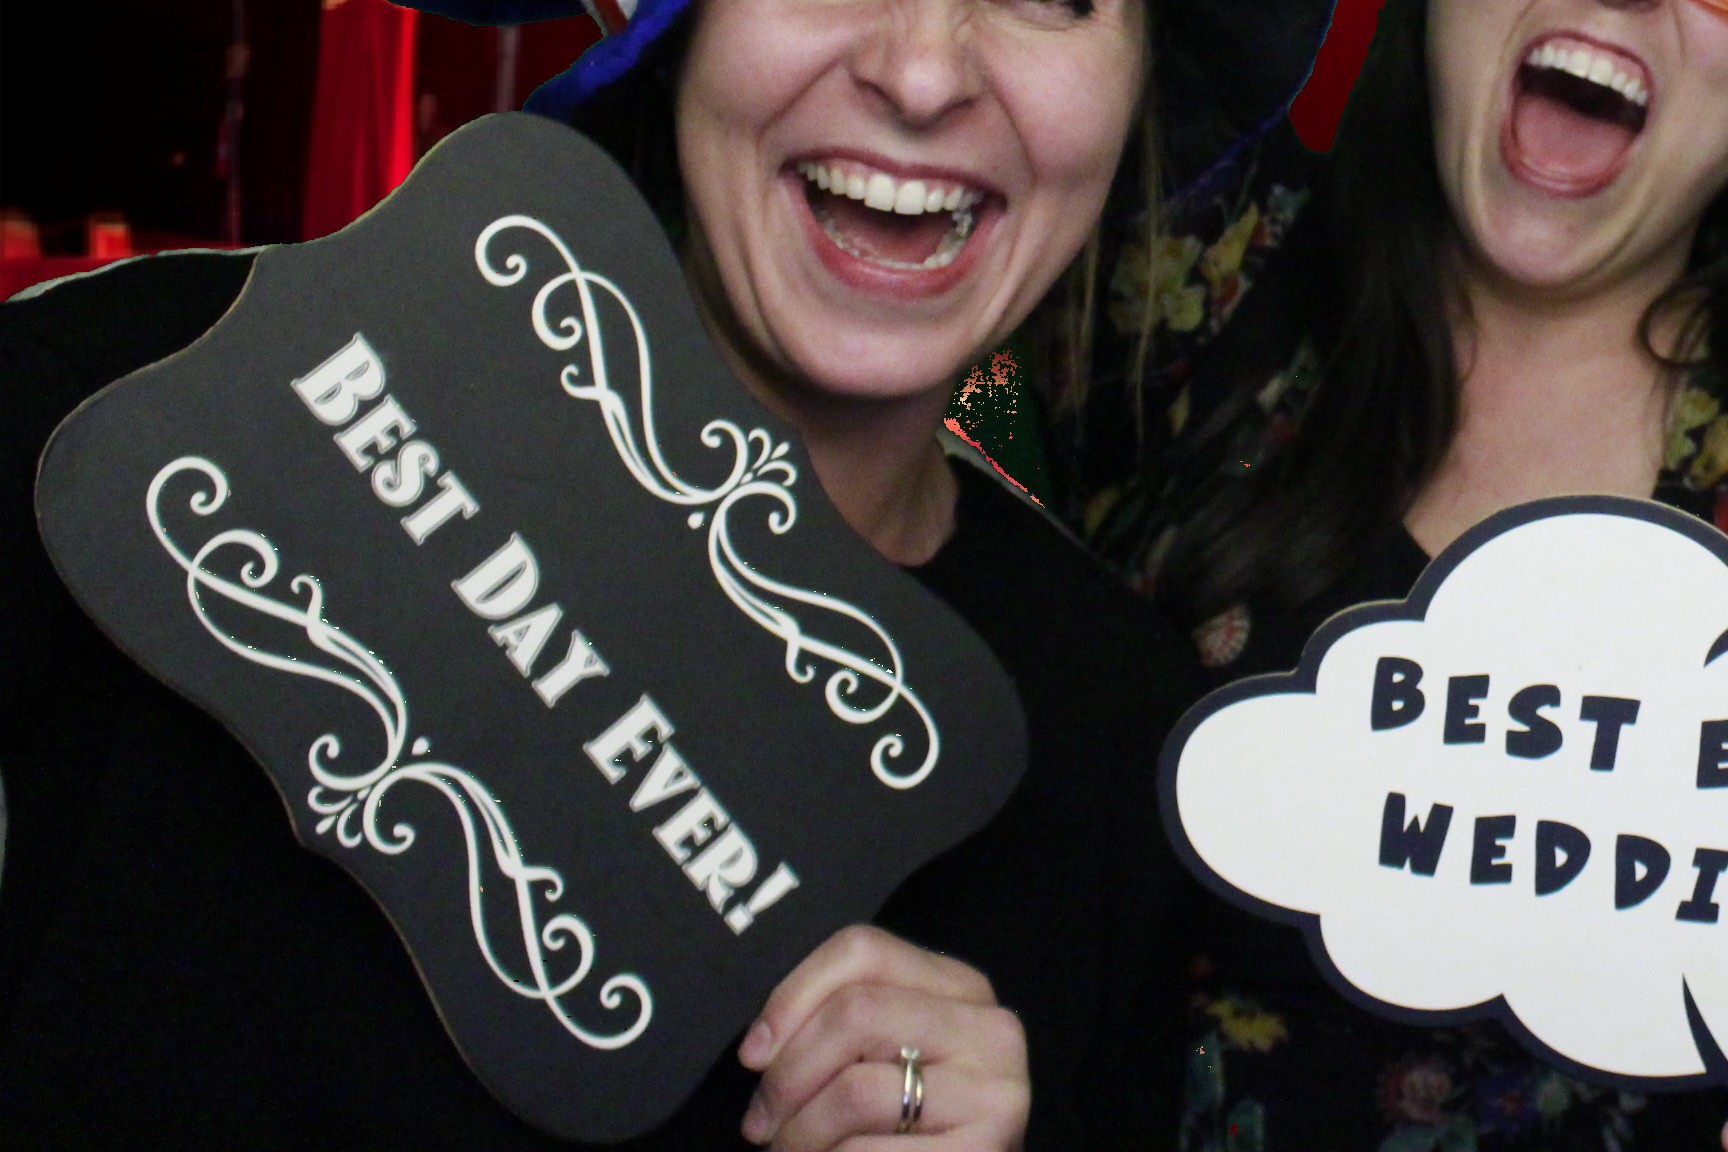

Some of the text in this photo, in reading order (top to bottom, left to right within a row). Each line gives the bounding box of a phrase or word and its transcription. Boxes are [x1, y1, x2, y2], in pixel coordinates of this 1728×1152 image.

[291, 333, 800, 935] BEST DAY EVER!
[1369, 655, 1642, 772] BEST
